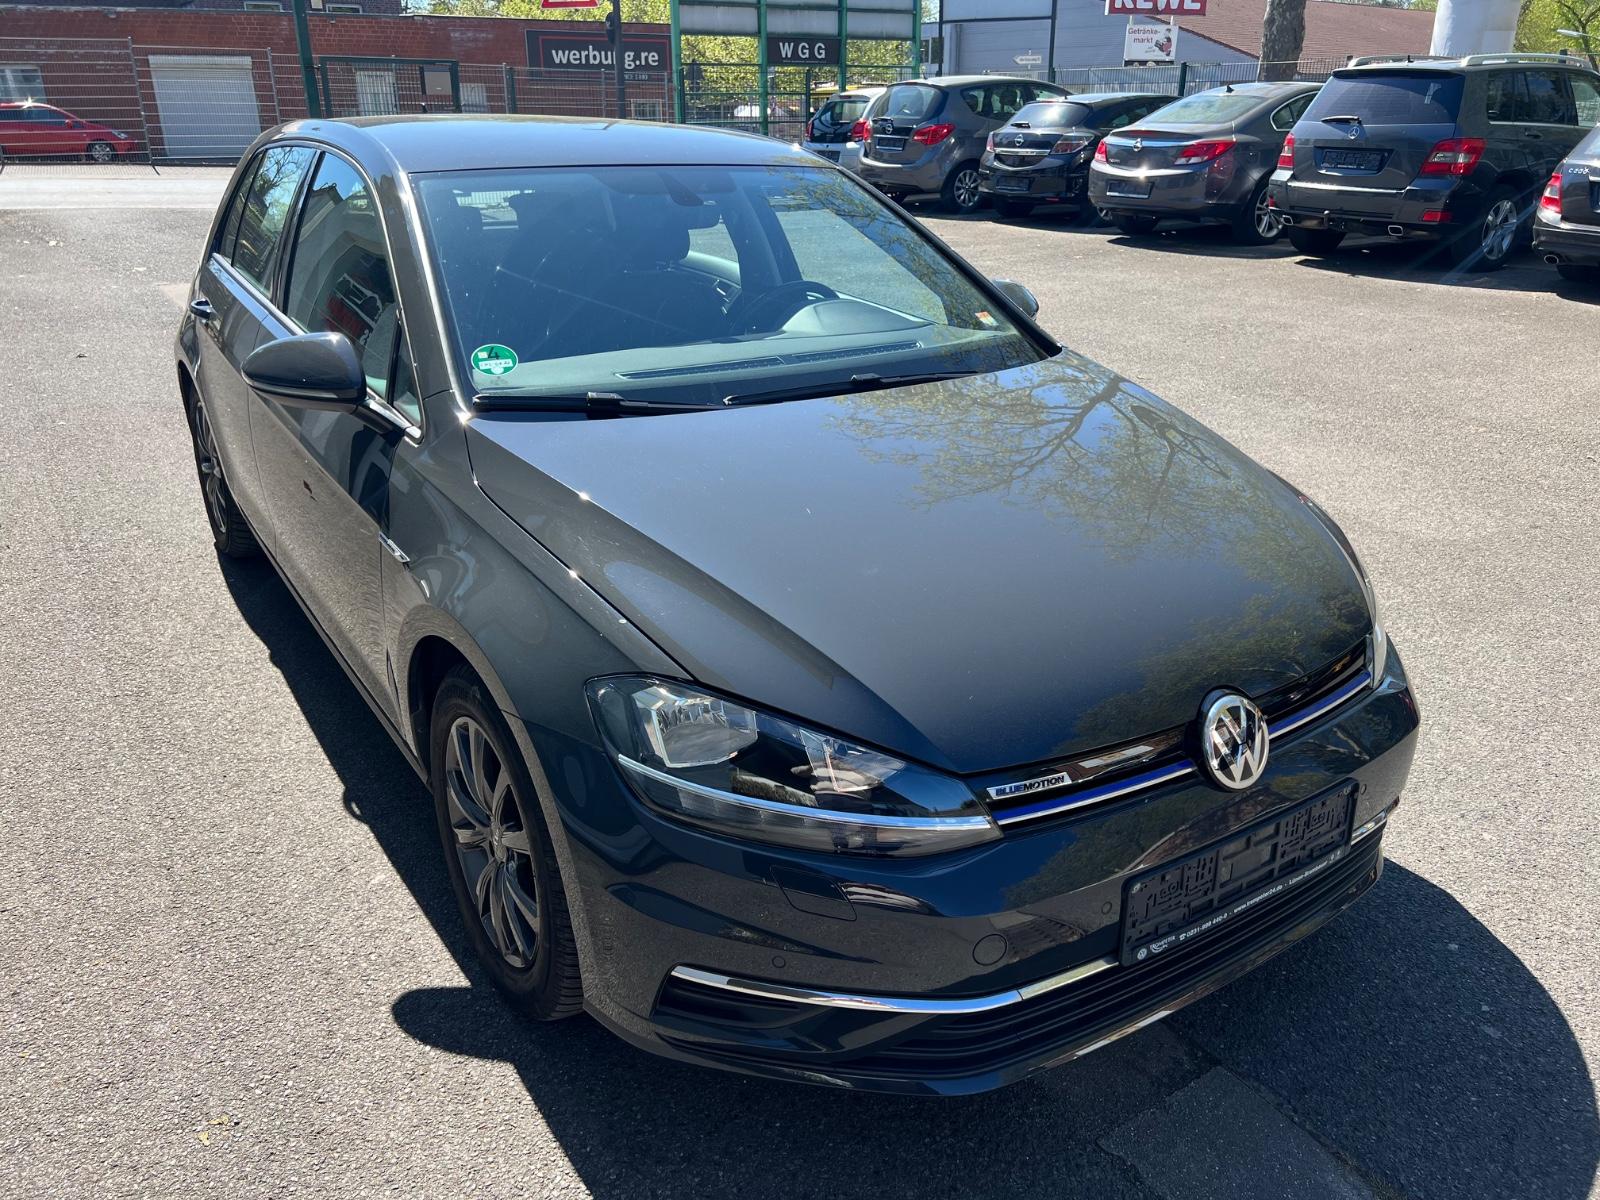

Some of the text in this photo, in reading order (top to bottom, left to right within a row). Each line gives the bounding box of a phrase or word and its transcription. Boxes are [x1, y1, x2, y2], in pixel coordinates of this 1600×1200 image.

[551, 45, 659, 70] werbug.re
[488, 346, 499, 360] 4
[995, 775, 1065, 796] BLUEMOTION
